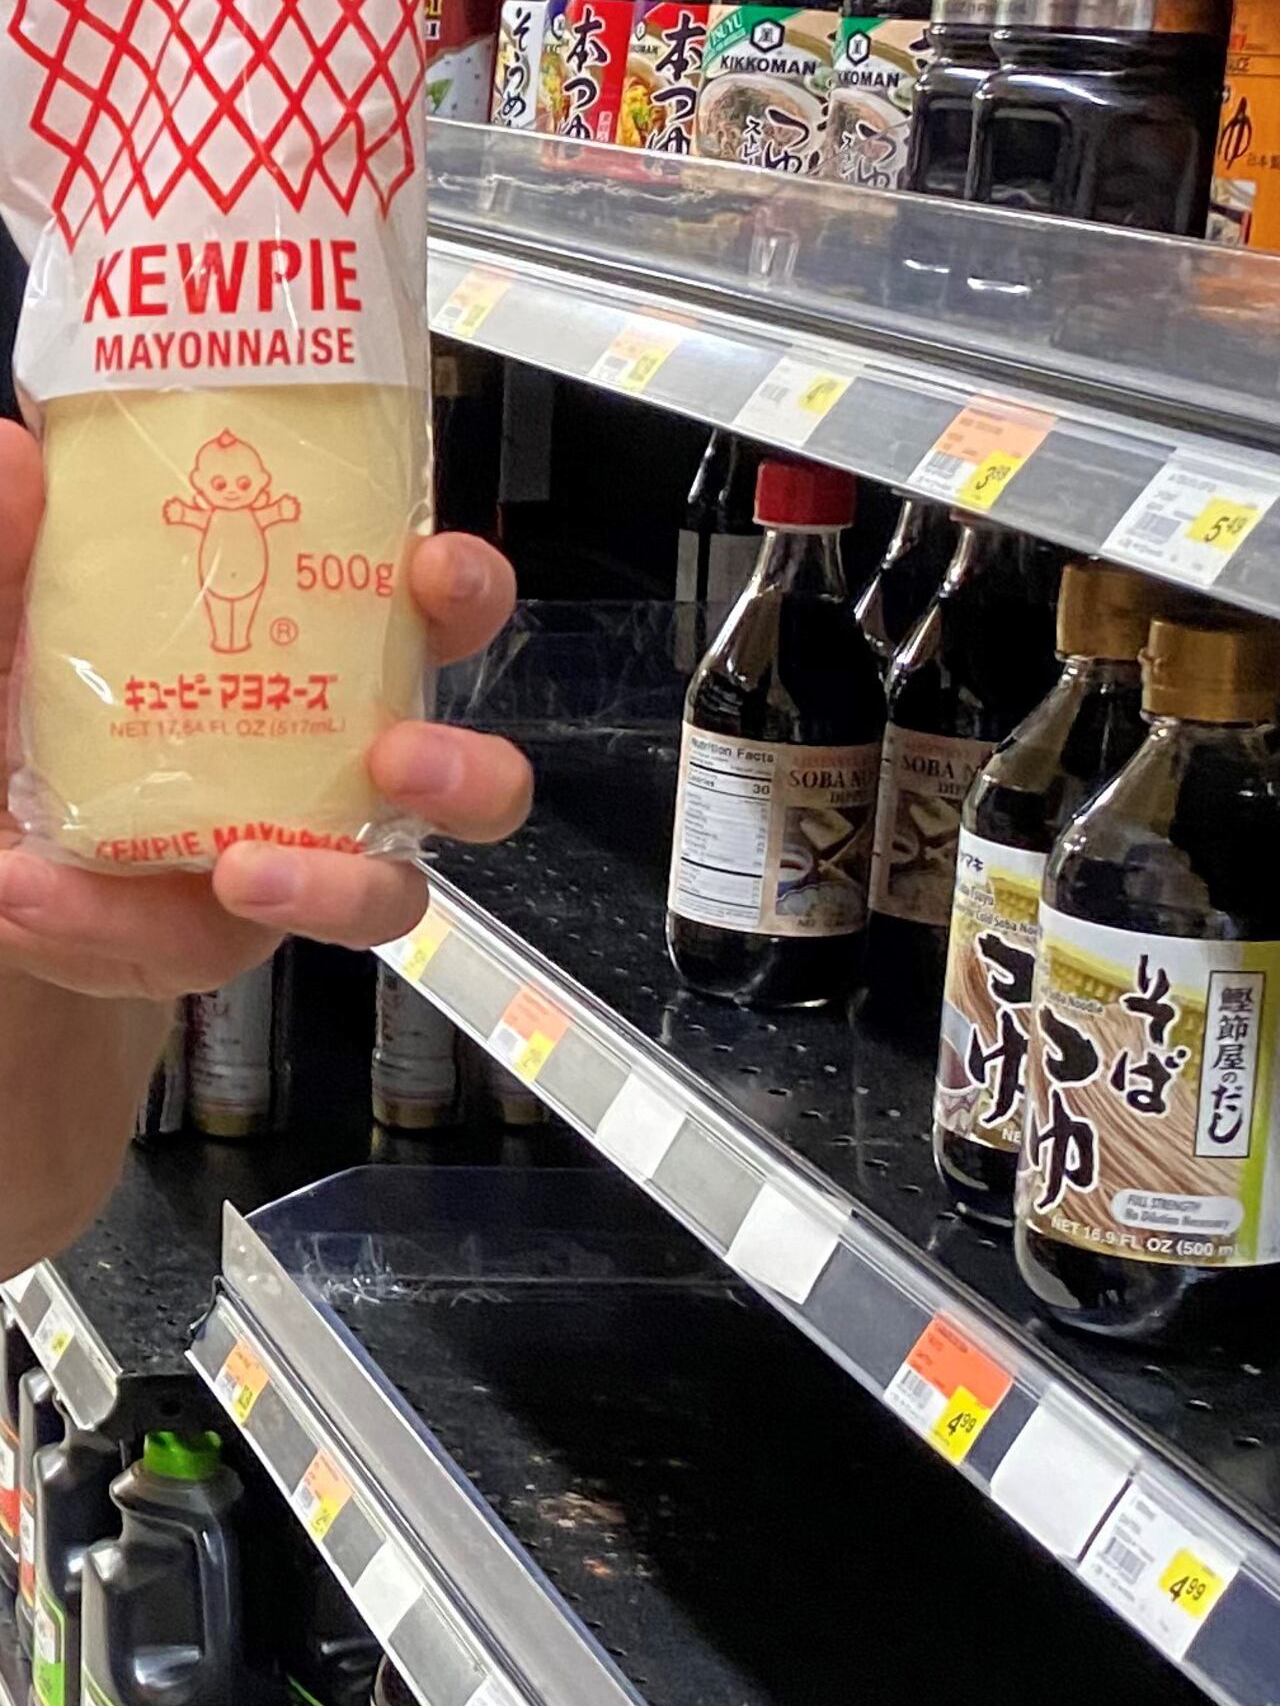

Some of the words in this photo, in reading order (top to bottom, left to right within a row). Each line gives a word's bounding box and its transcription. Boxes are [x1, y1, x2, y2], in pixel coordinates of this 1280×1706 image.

[719, 54, 818, 76] KIKKOMAN
[83, 238, 362, 325] KEWPIE
[94, 327, 356, 373] MAYONNAISE
[296, 553, 395, 598] 500g
[124, 673, 212, 713] キューピー
[218, 673, 339, 712] マヨネーズ
[110, 721, 151, 738] NET
[236, 719, 268, 737] OZ
[736, 748, 775, 764] Facts
[901, 753, 955, 781] SOBA
[789, 769, 845, 790] SOBA
[1109, 953, 1192, 1116] そば
[1028, 1004, 1100, 1212] つゆ
[1051, 1216, 1080, 1235] NET
[1083, 1225, 1116, 1245] 16.9
[1119, 1233, 1139, 1250] FL
[1146, 1237, 1173, 1254] OZ
[1175, 1240, 1214, 1257] (500
